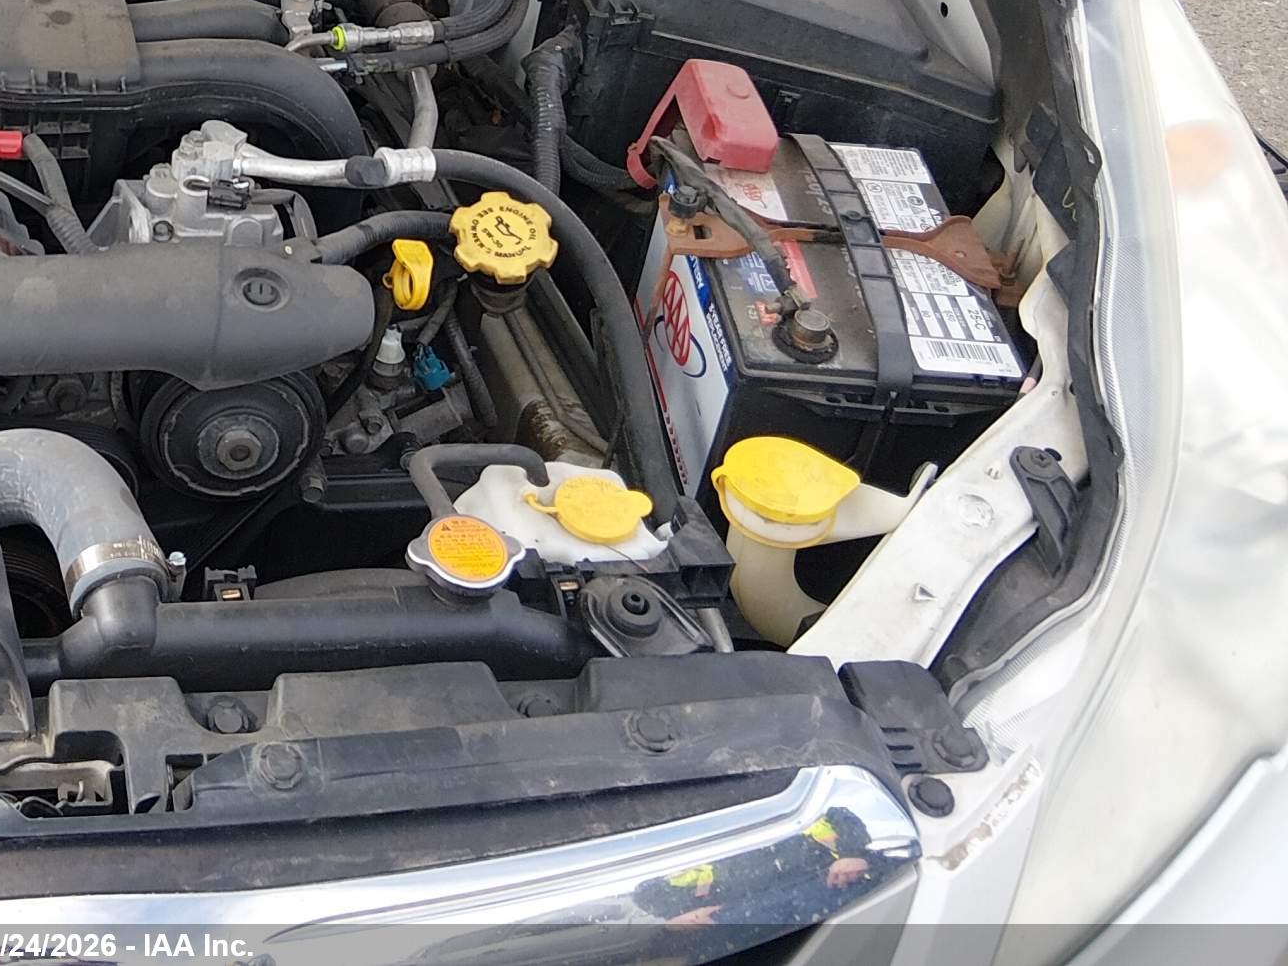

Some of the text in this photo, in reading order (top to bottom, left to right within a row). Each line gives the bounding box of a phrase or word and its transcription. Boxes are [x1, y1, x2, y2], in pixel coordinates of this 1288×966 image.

[477, 207, 494, 218] SEE
[495, 245, 531, 257] MANUAL
[499, 206, 536, 240] ENGINE OIL
[663, 271, 690, 365] AAA
[967, 309, 987, 331] 25-C
